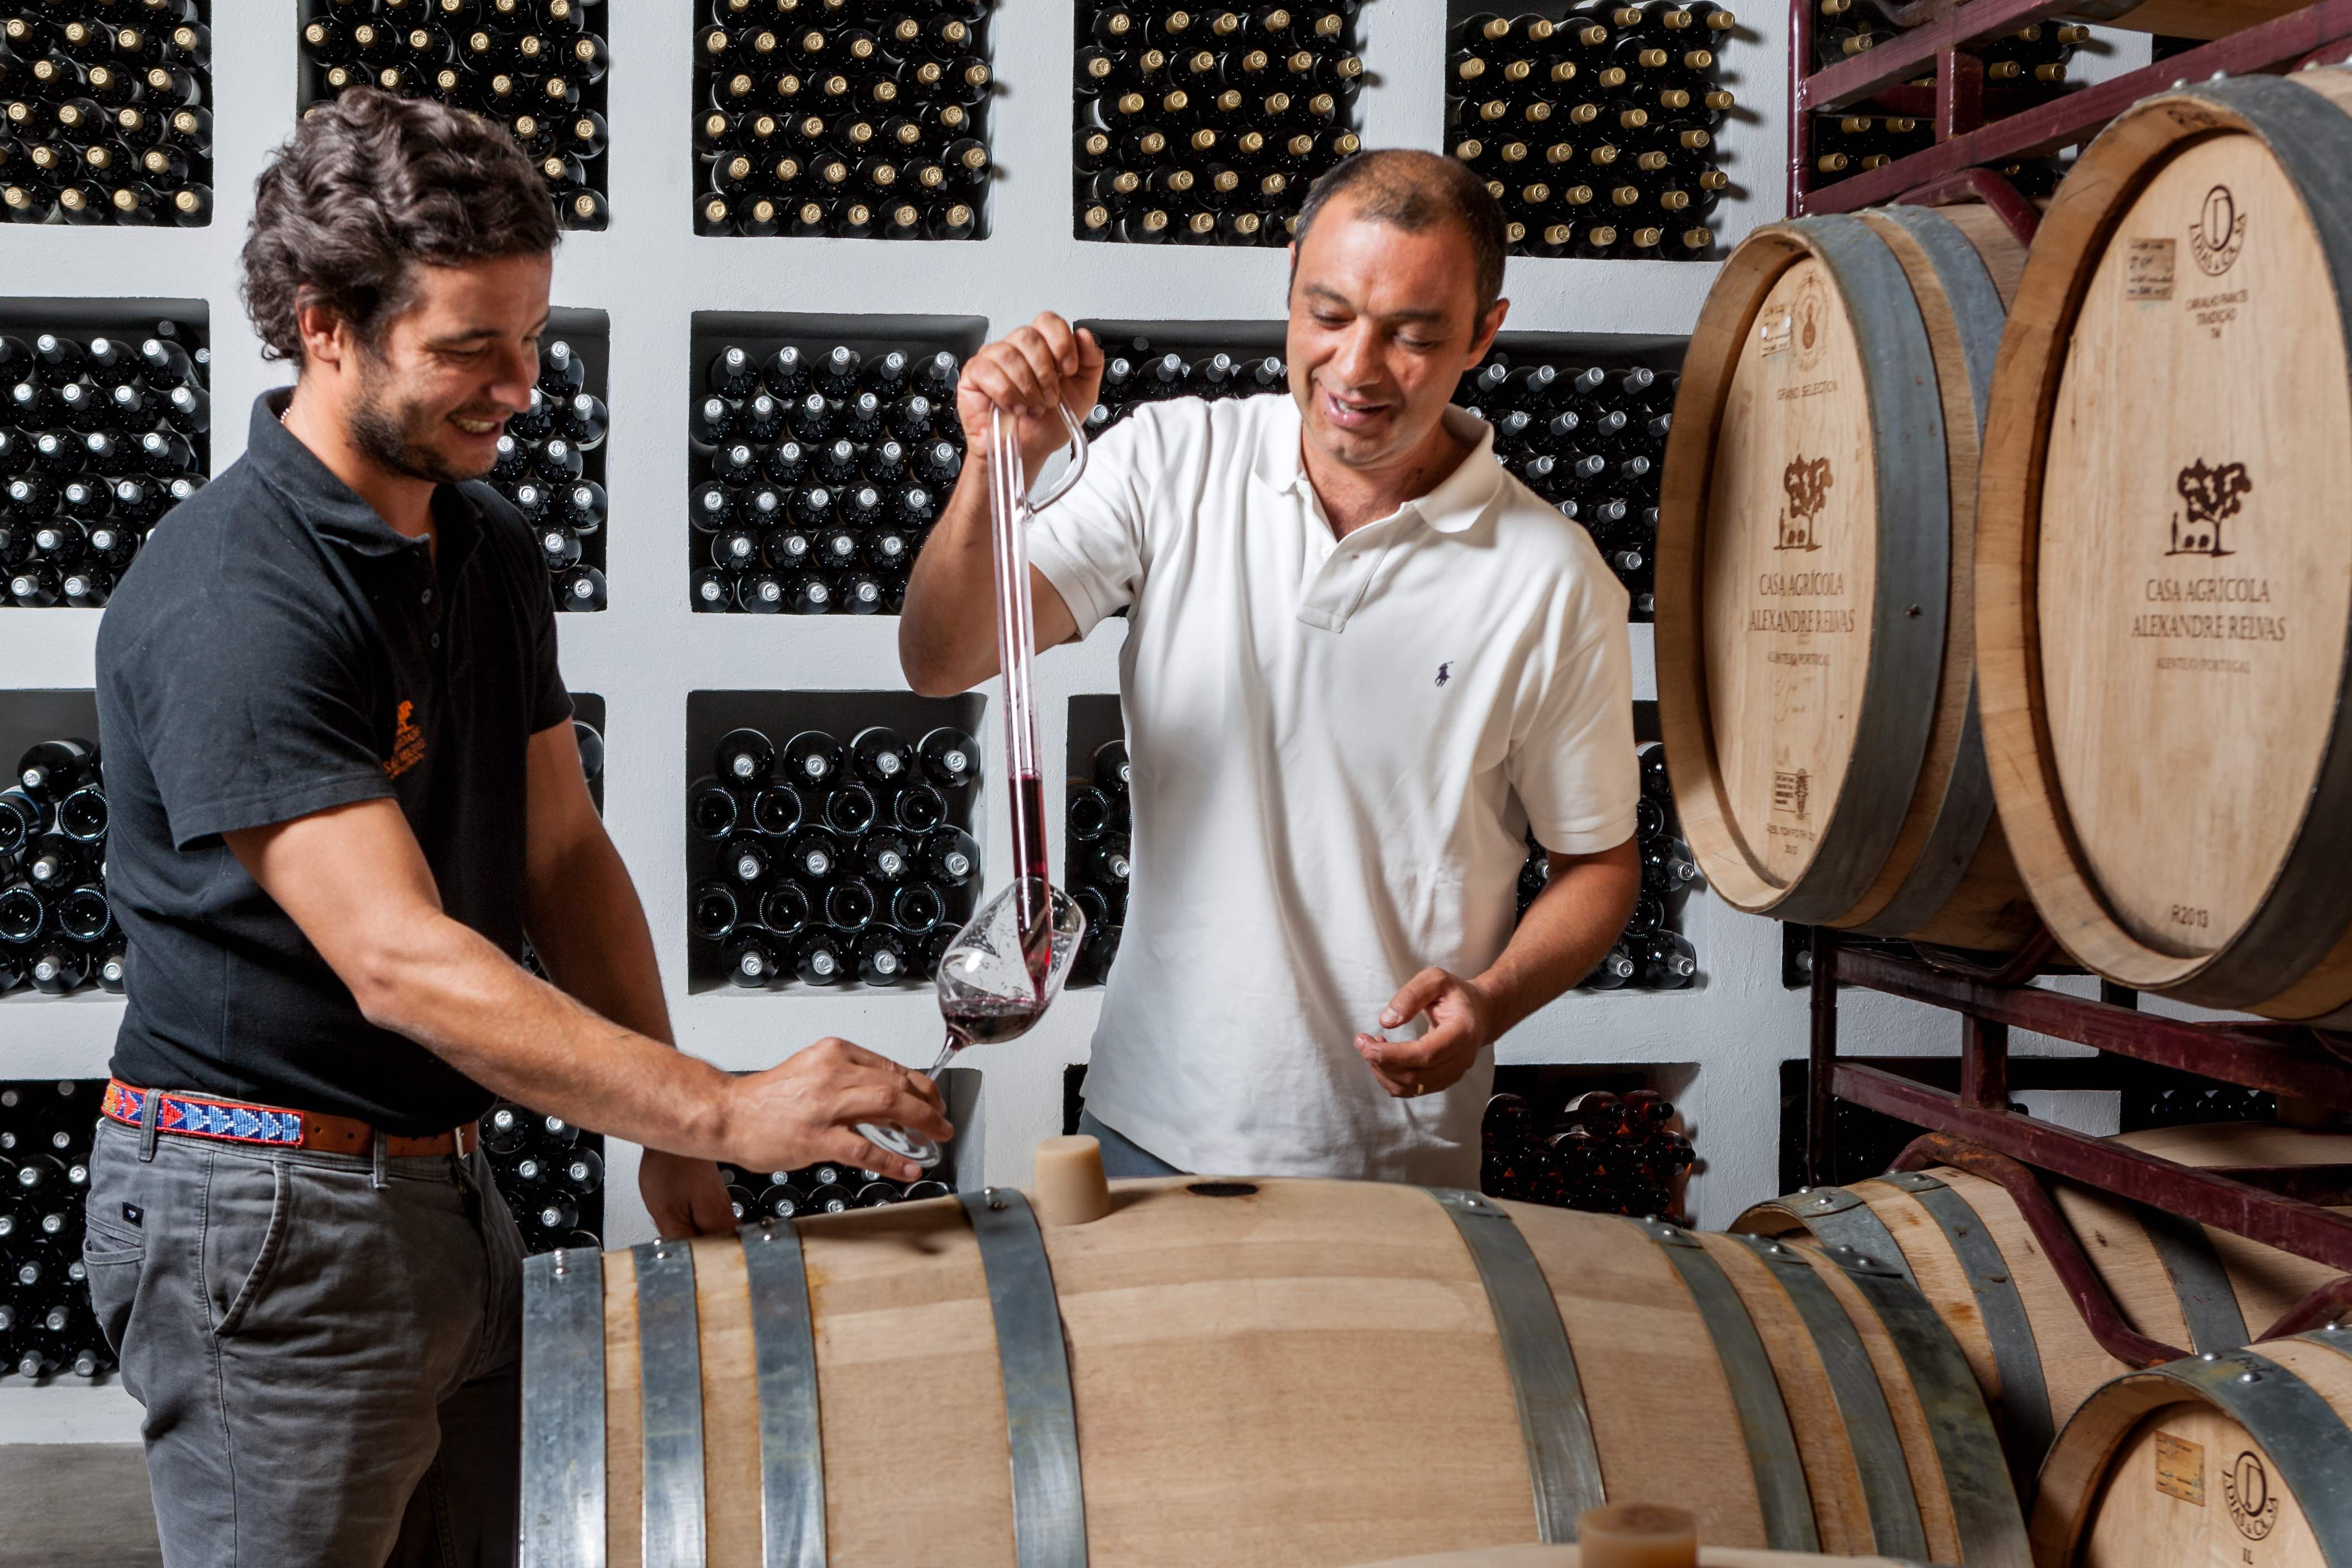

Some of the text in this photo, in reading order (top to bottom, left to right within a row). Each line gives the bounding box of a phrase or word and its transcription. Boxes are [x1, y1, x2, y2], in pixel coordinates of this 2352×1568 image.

[1760, 570, 1844, 596] CASA AGRÍCOLA
[2146, 577, 2270, 603] CASA AGRÍCOLA
[1748, 609, 1856, 632] ALEXANDRE RELVAS
[2131, 615, 2287, 642] ALEXANDRE RELVAS
